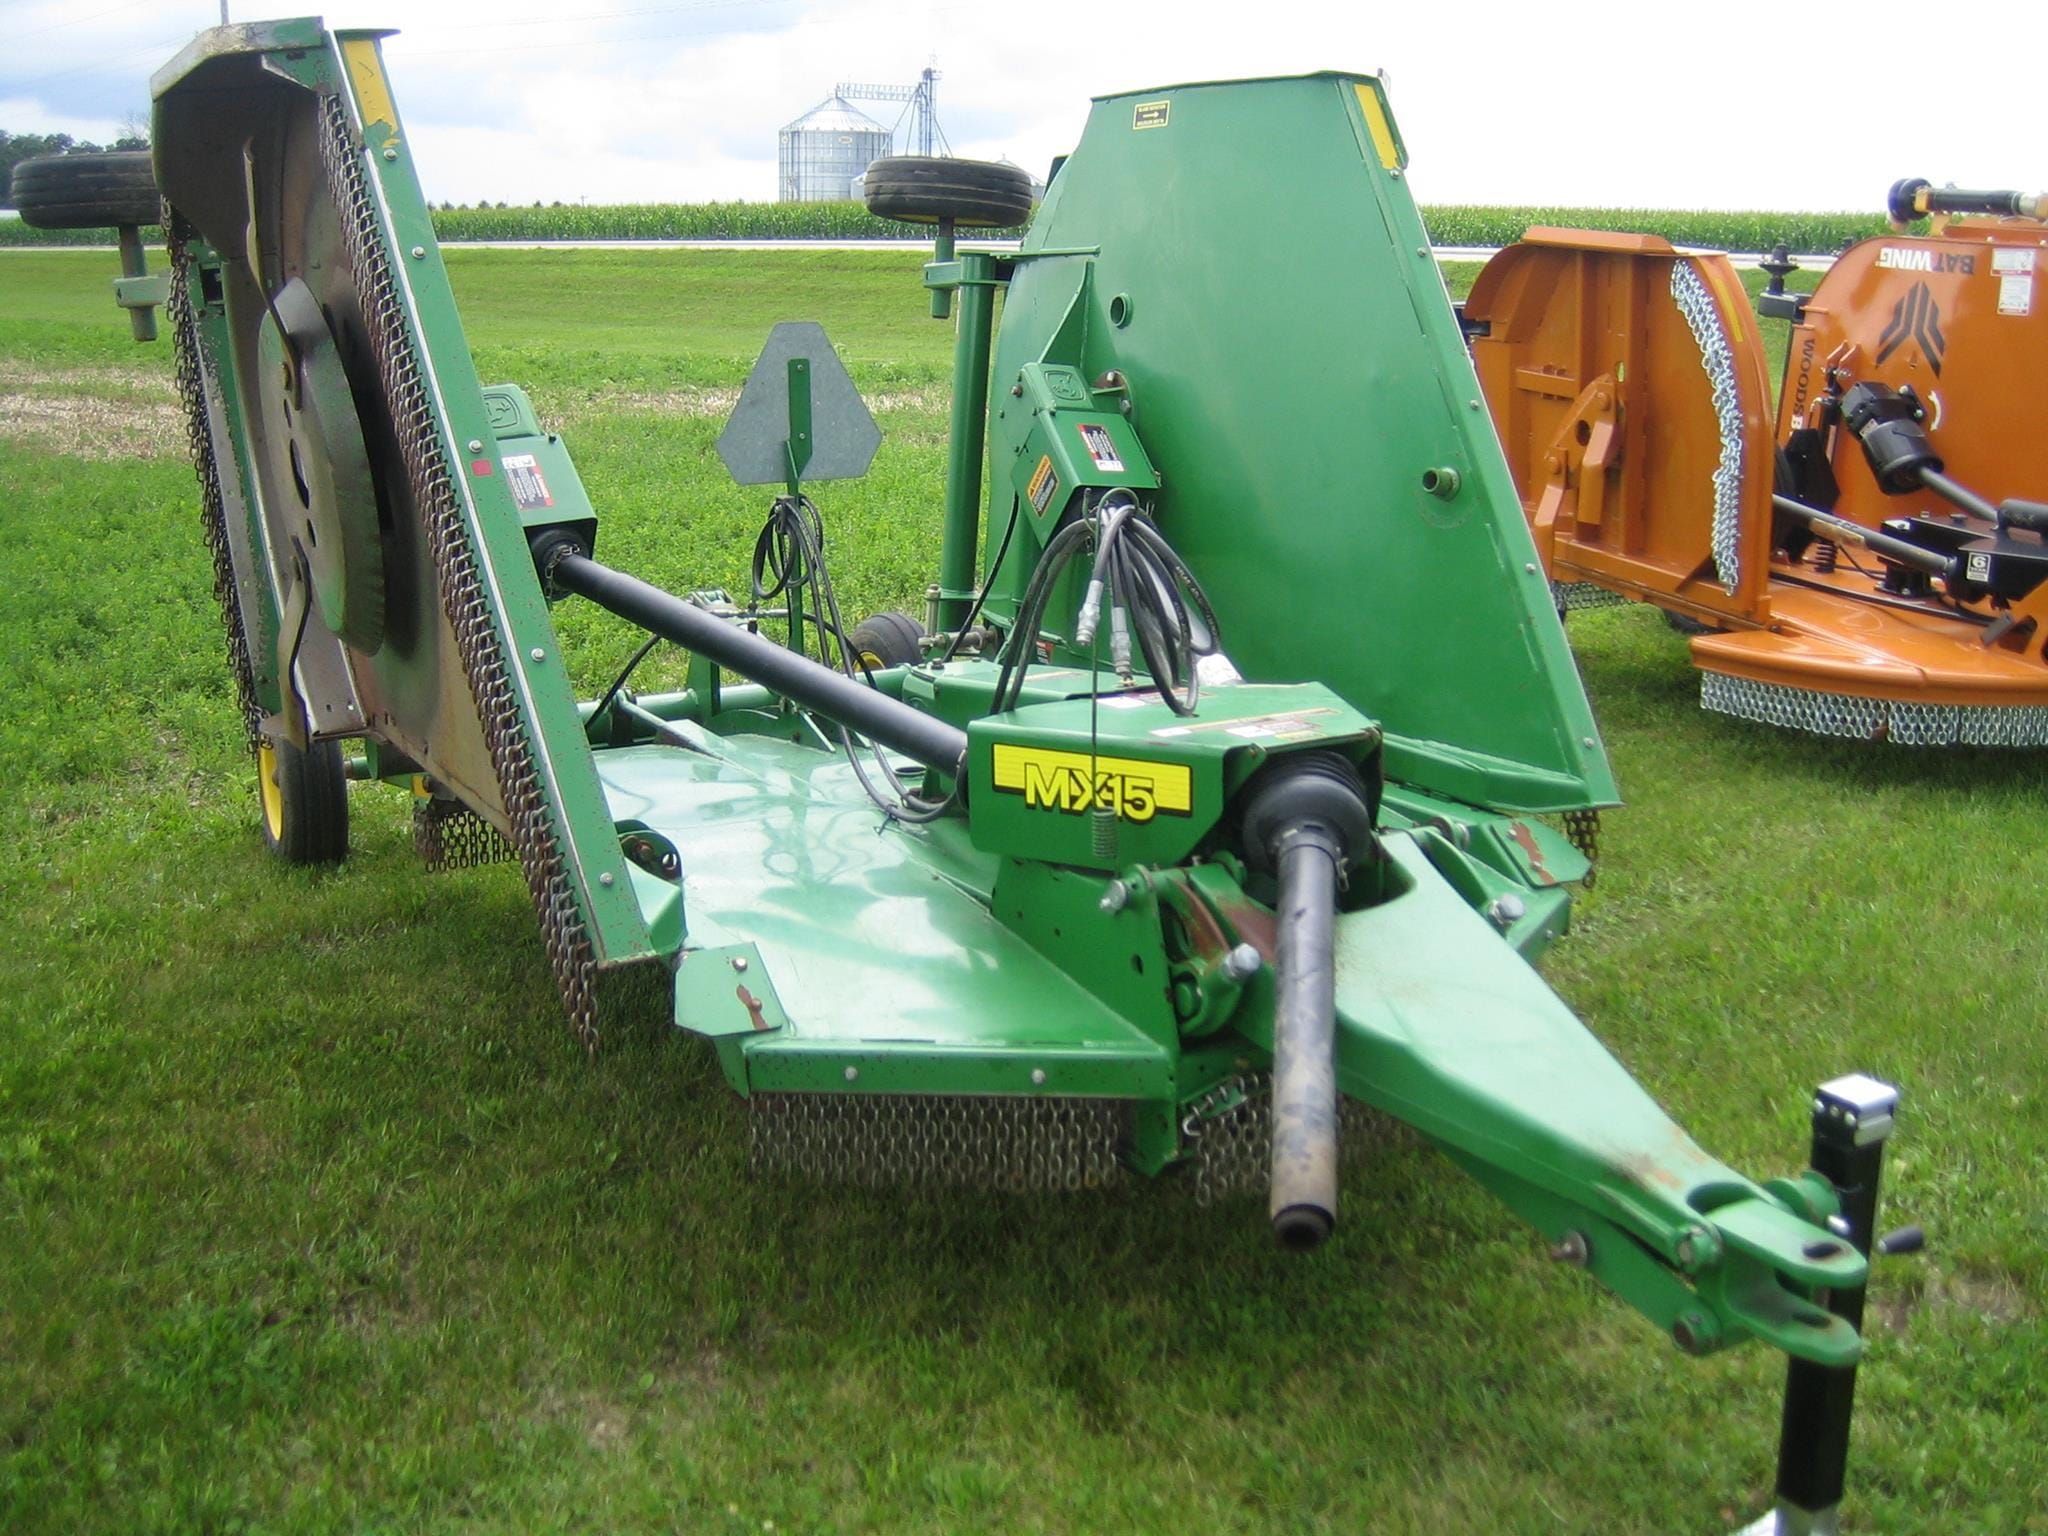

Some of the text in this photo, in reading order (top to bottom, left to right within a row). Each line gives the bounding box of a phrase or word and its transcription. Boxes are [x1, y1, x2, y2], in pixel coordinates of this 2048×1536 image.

[1880, 247, 1976, 275] BATWING
[1793, 338, 1816, 416] WOODS
[1972, 556, 1986, 568] 6
[1024, 762, 1156, 823] MX15
